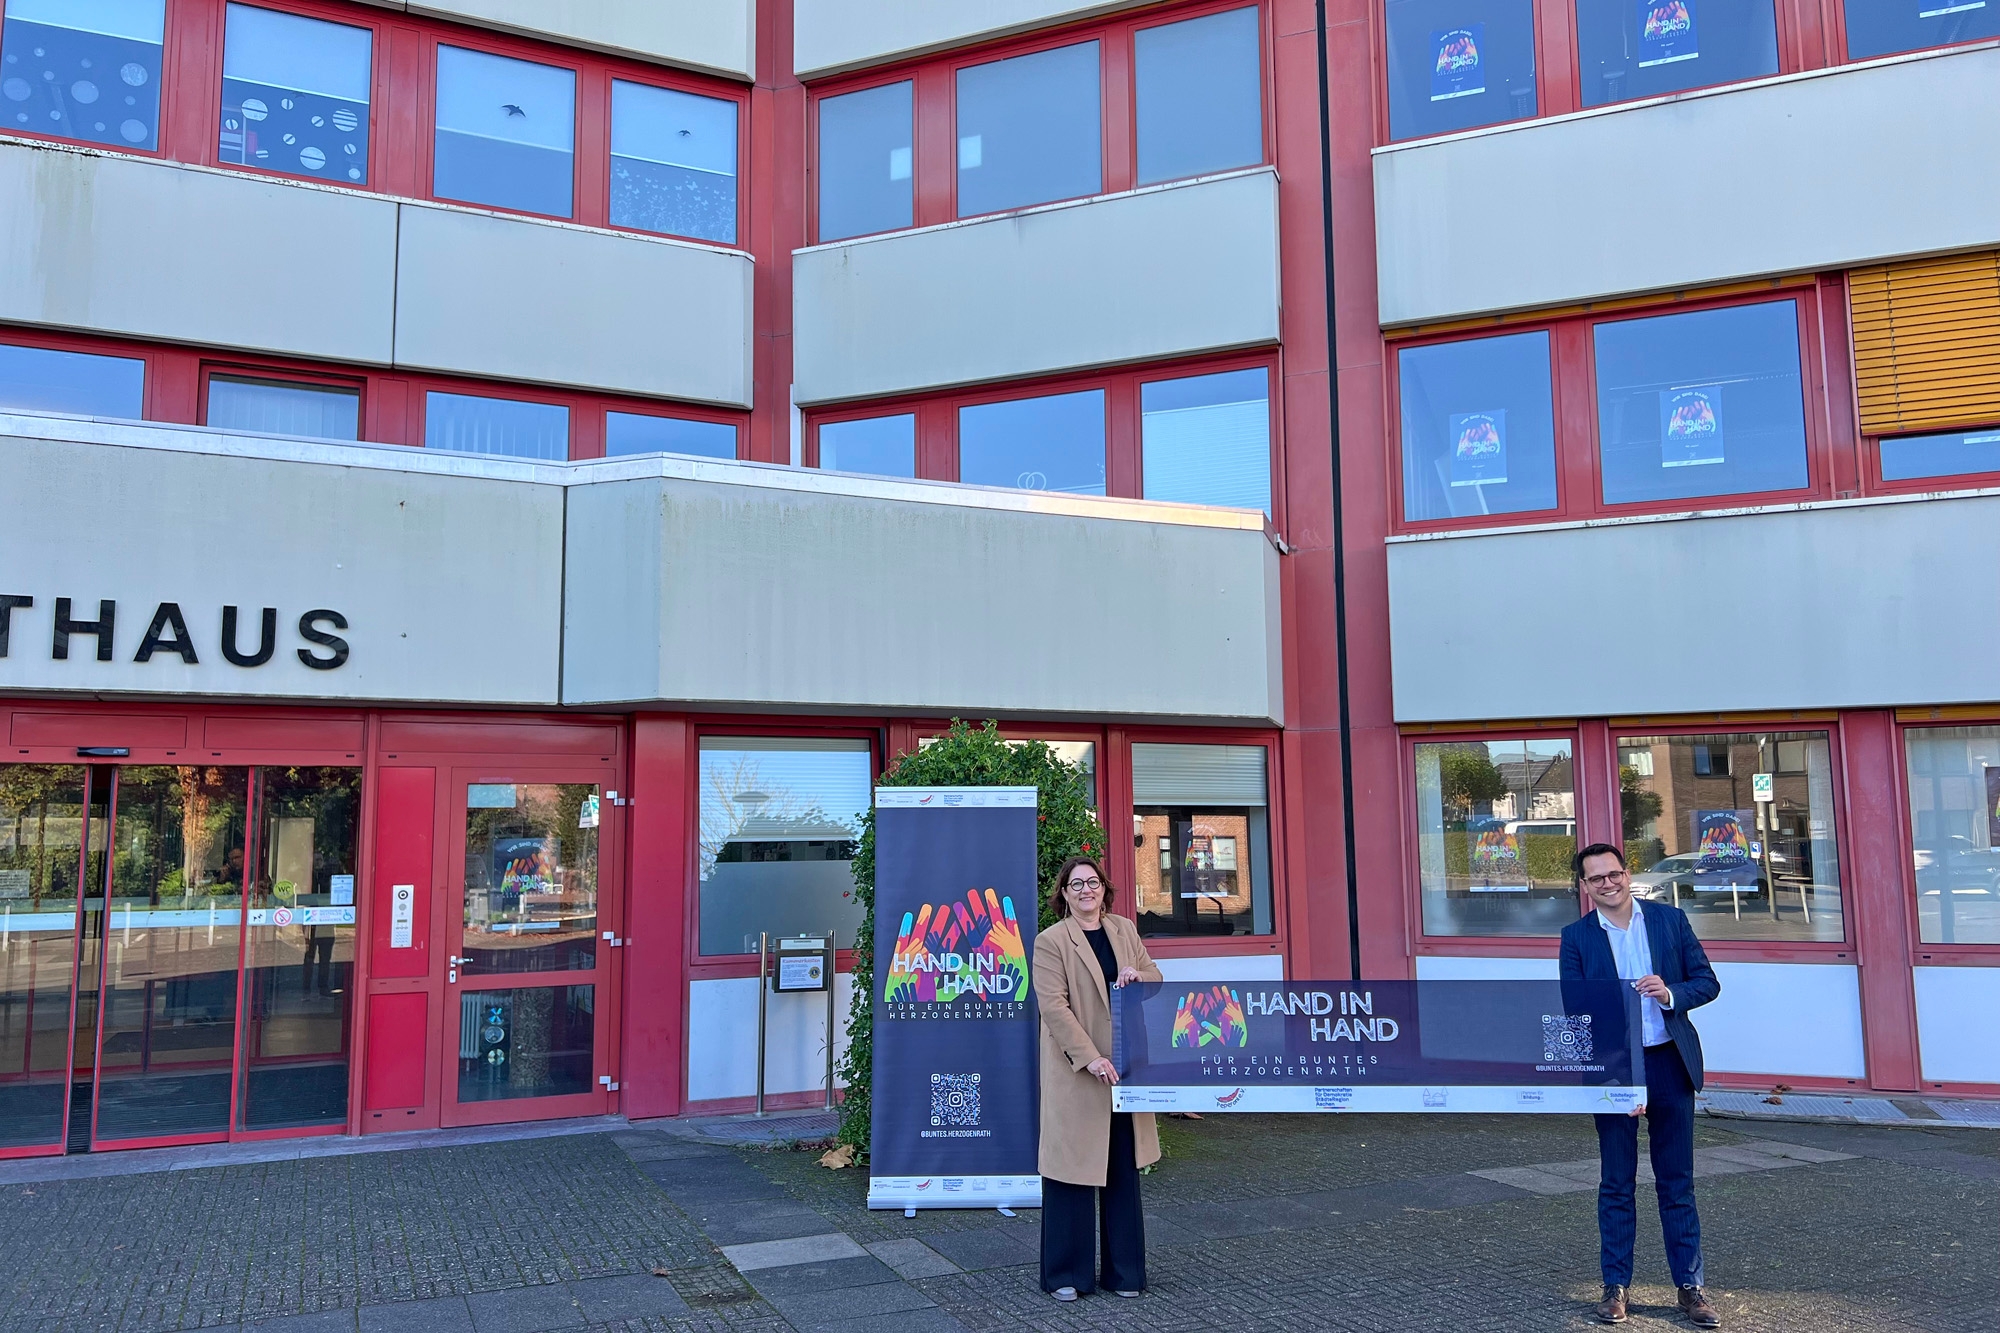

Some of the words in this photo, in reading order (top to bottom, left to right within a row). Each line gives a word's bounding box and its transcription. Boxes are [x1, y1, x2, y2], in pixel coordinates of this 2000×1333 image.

[504, 874, 530, 882] HAND
[532, 874, 542, 882] IN
[278, 886, 290, 894] WC
[894, 952, 963, 972] HAND
[968, 952, 994, 972] IN
[944, 974, 1014, 994] HAND
[888, 1002, 914, 1010] FÜR
[964, 1002, 1024, 1010] BUNTES
[1246, 992, 1333, 1016] HAND
[1340, 992, 1372, 1015] IN
[890, 1011, 1014, 1019] HERZOGENRATH
[1310, 1018, 1399, 1042] HAND
[1201, 1054, 1236, 1064] FÜR
[1252, 1056, 1283, 1064] EIN
[1300, 1056, 1378, 1064] BUNTES
[1204, 1066, 1366, 1076] HERZOGENRATH
[920, 1130, 990, 1138] @BUNTES.HERZOGENRATH
